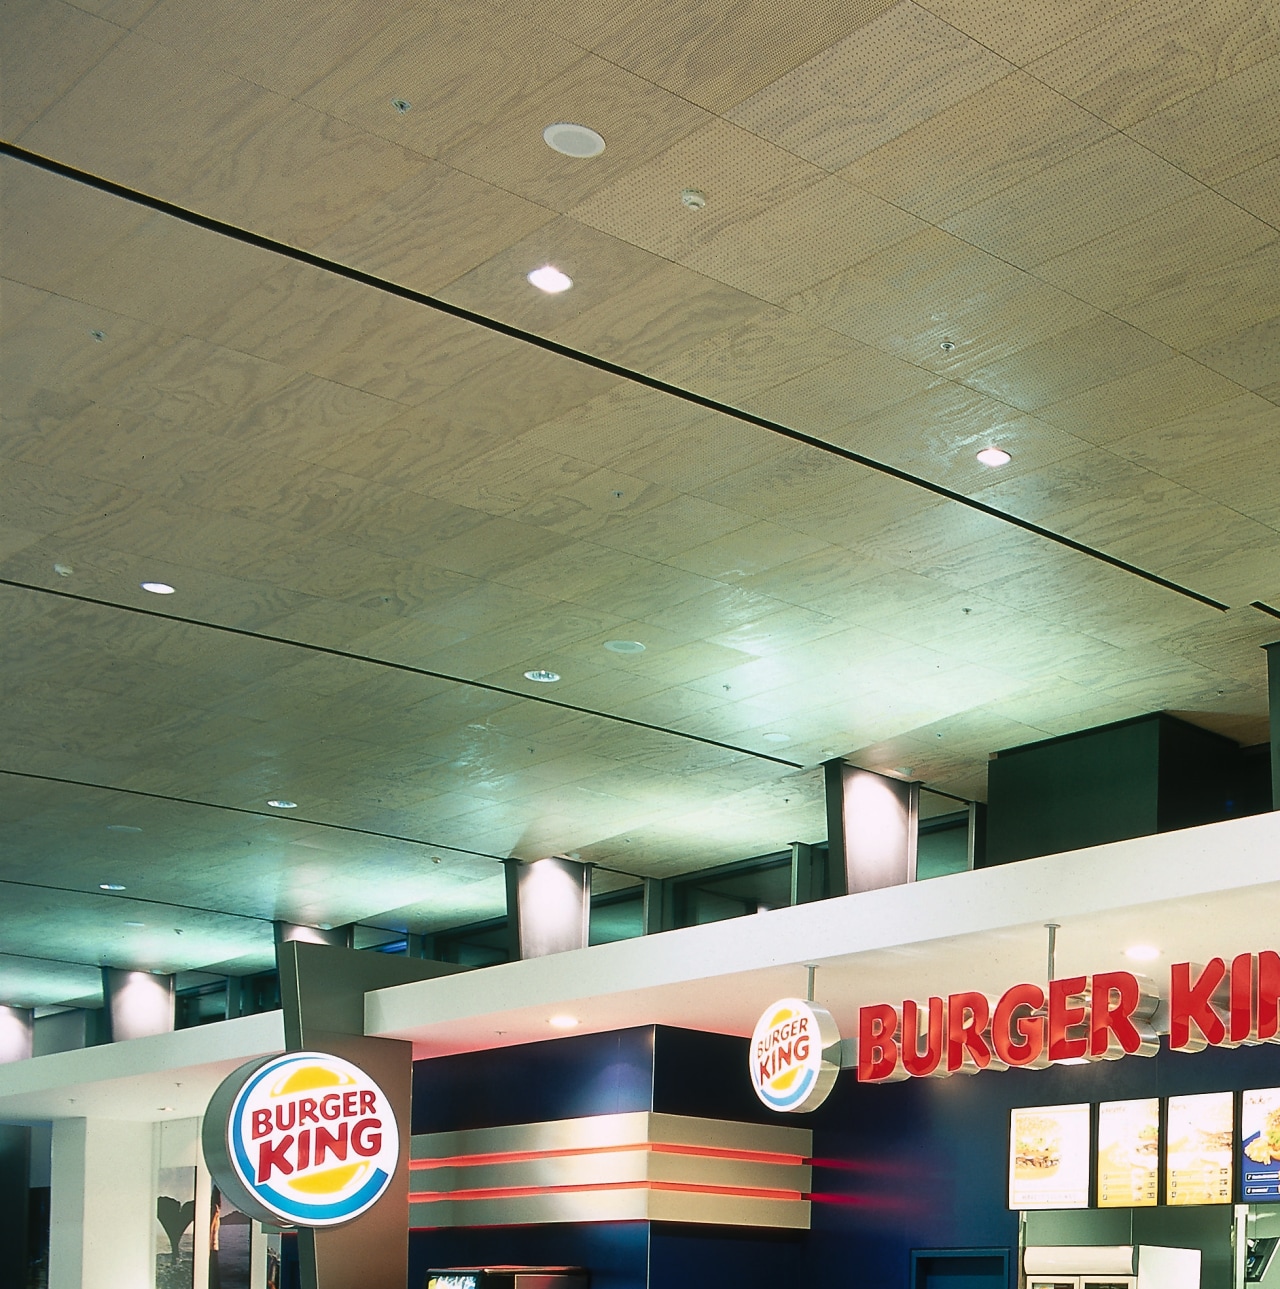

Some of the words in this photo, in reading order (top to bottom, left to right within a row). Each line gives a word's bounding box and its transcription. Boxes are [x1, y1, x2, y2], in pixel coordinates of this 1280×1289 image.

[757, 1017, 809, 1059] BURGER
[858, 971, 1141, 1083] BURGER
[759, 1035, 810, 1087] KING
[252, 1090, 377, 1141] BURGER
[258, 1118, 382, 1183] KING
